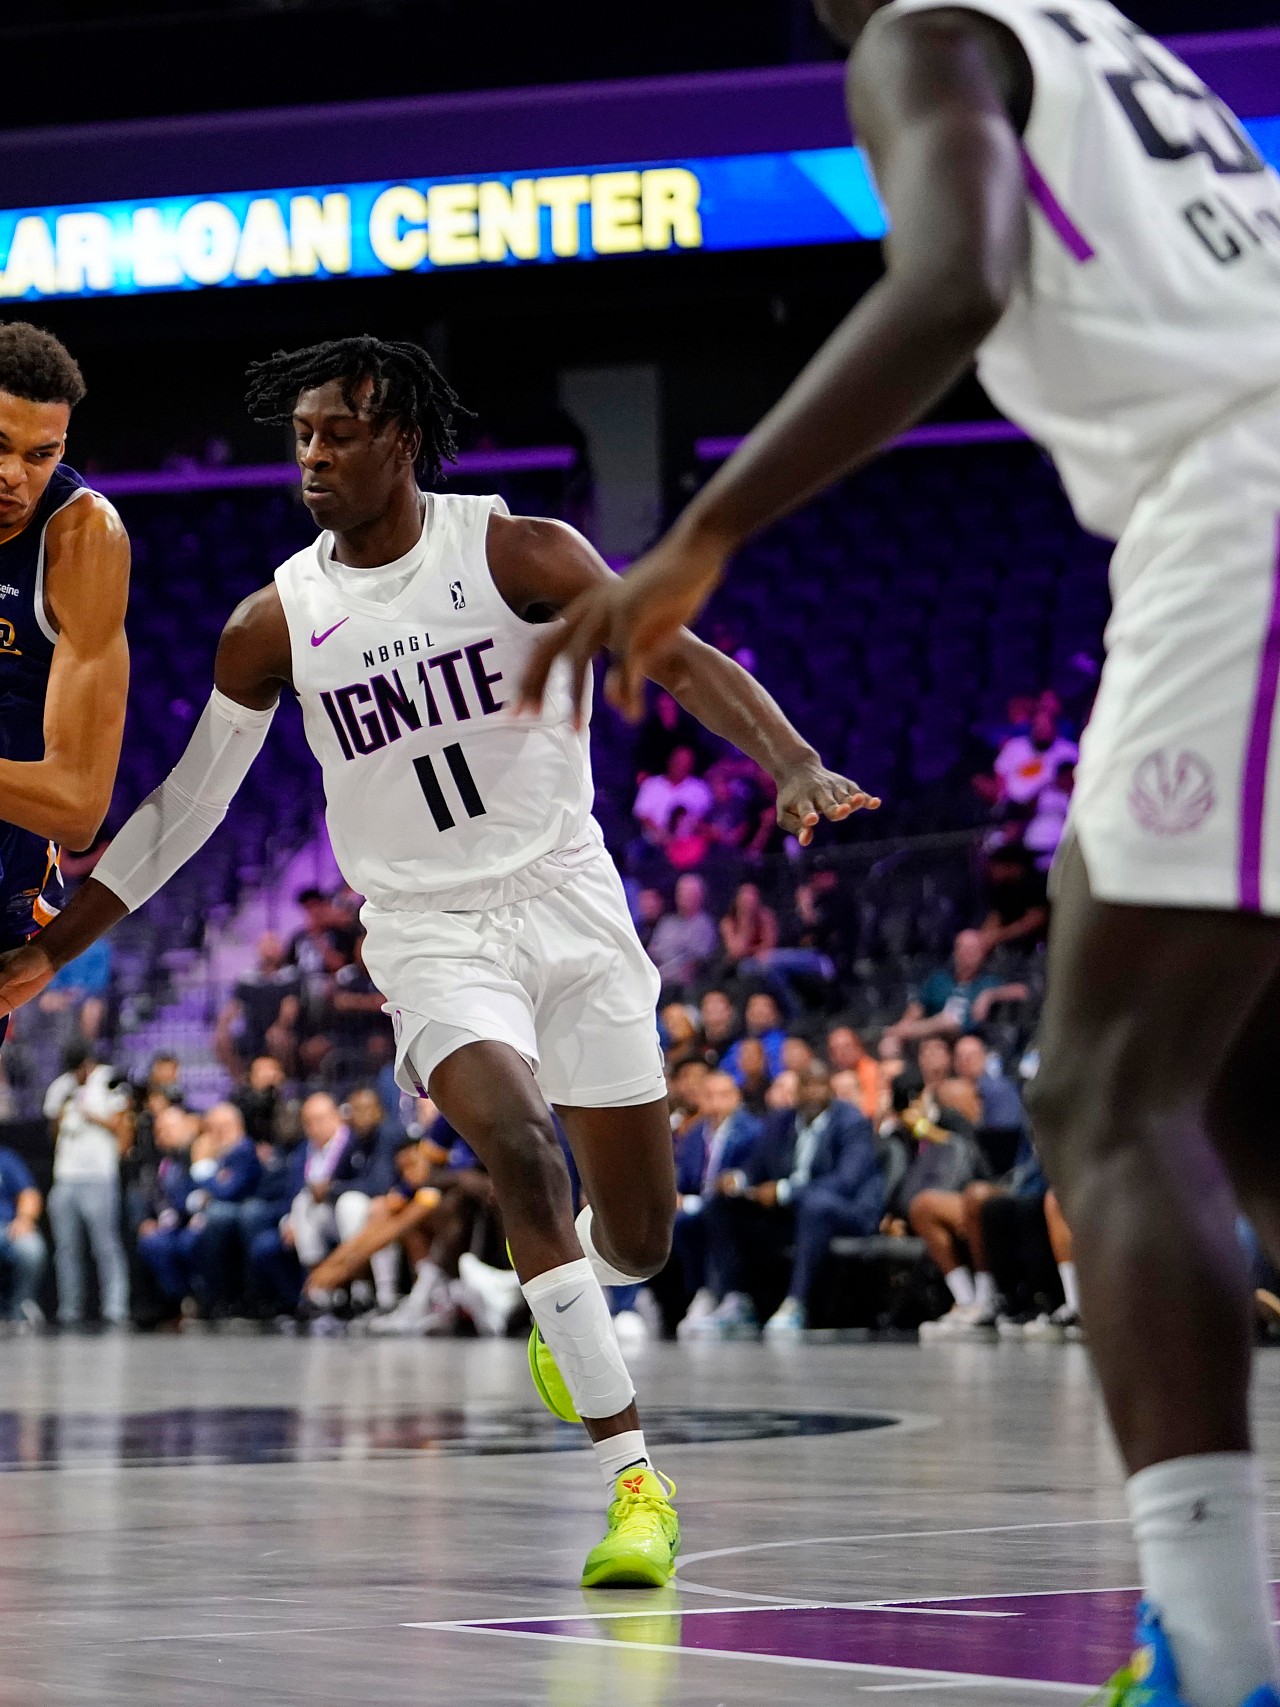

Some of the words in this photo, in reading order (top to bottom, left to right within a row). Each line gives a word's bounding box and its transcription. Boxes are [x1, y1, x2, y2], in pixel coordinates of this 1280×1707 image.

[131, 191, 352, 288] LOAN
[369, 167, 703, 271] CENTER
[319, 638, 504, 761] IGNITE
[362, 632, 435, 668] NBAGL
[412, 742, 487, 833] 11
